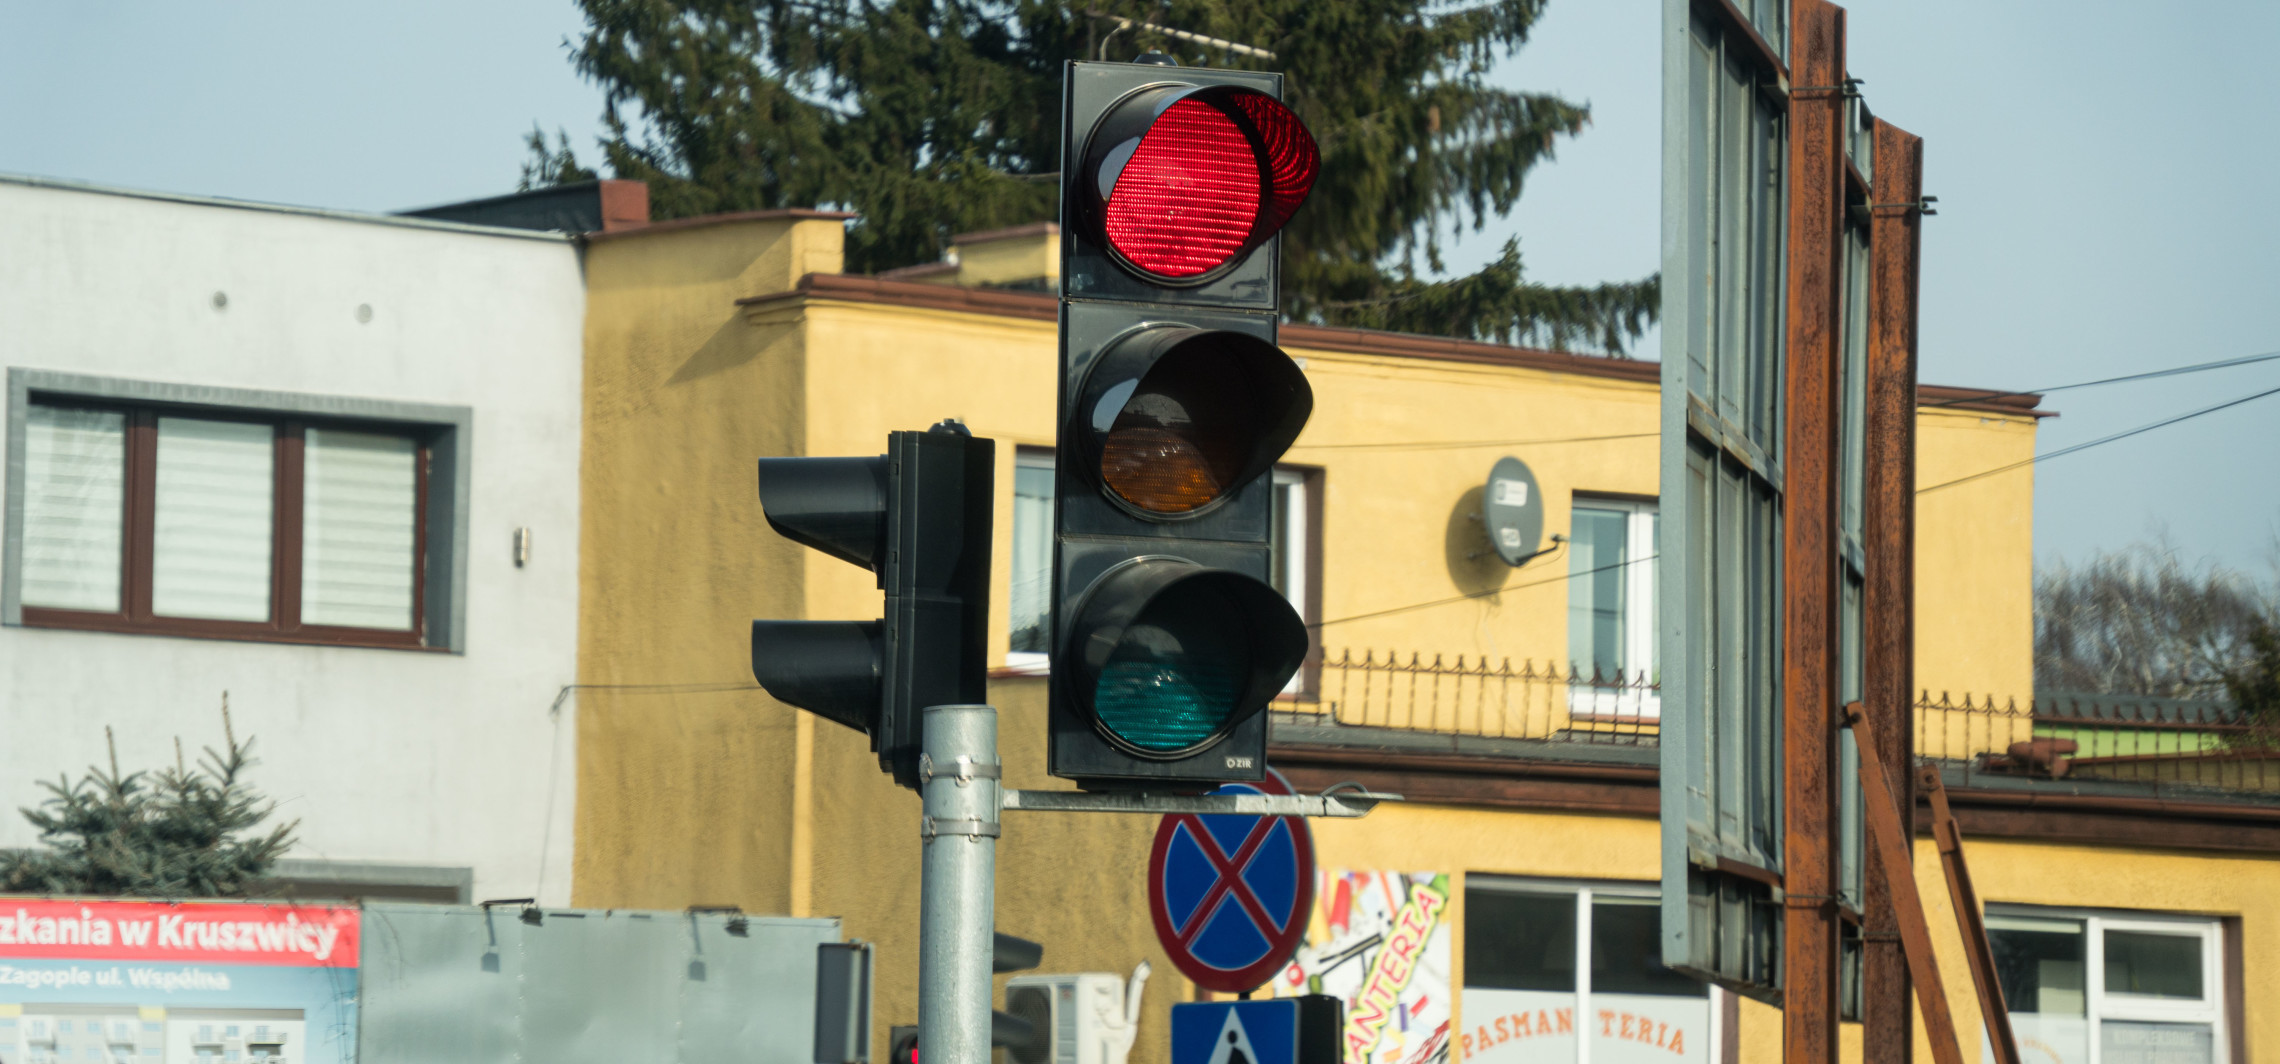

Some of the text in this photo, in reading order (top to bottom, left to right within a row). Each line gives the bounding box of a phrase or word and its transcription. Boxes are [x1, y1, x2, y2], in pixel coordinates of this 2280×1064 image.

[1236, 758, 1252, 769] ZIR
[0, 907, 339, 961] zkania w Kruszwicy
[0, 966, 231, 993] Zagople ul. Wspólna
[1345, 890, 1438, 1064] ANTERIA
[1461, 1007, 1685, 1059] PASMAN TERIA
